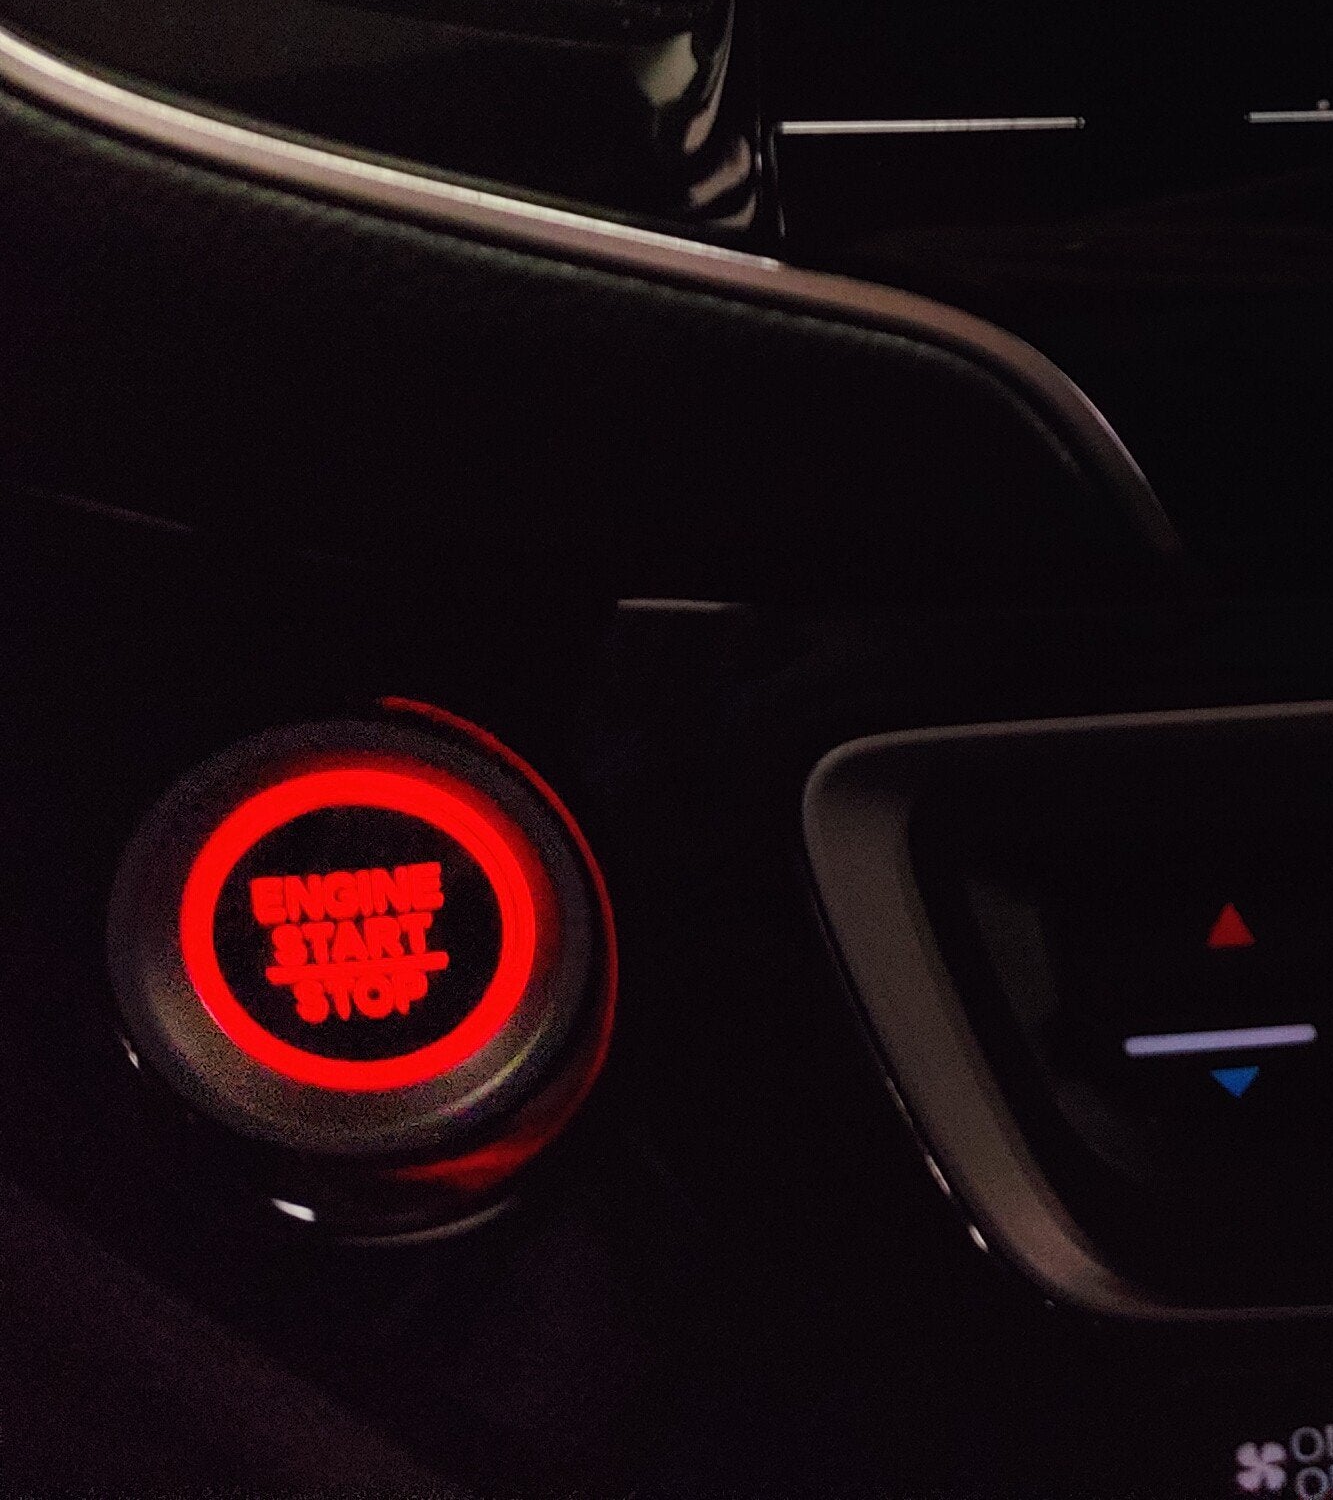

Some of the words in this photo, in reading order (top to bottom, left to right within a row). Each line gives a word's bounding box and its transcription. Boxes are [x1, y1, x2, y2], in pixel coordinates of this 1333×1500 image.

[250, 861, 445, 927] ENGINE
[271, 911, 434, 967] START
[292, 968, 429, 1025] STOP
